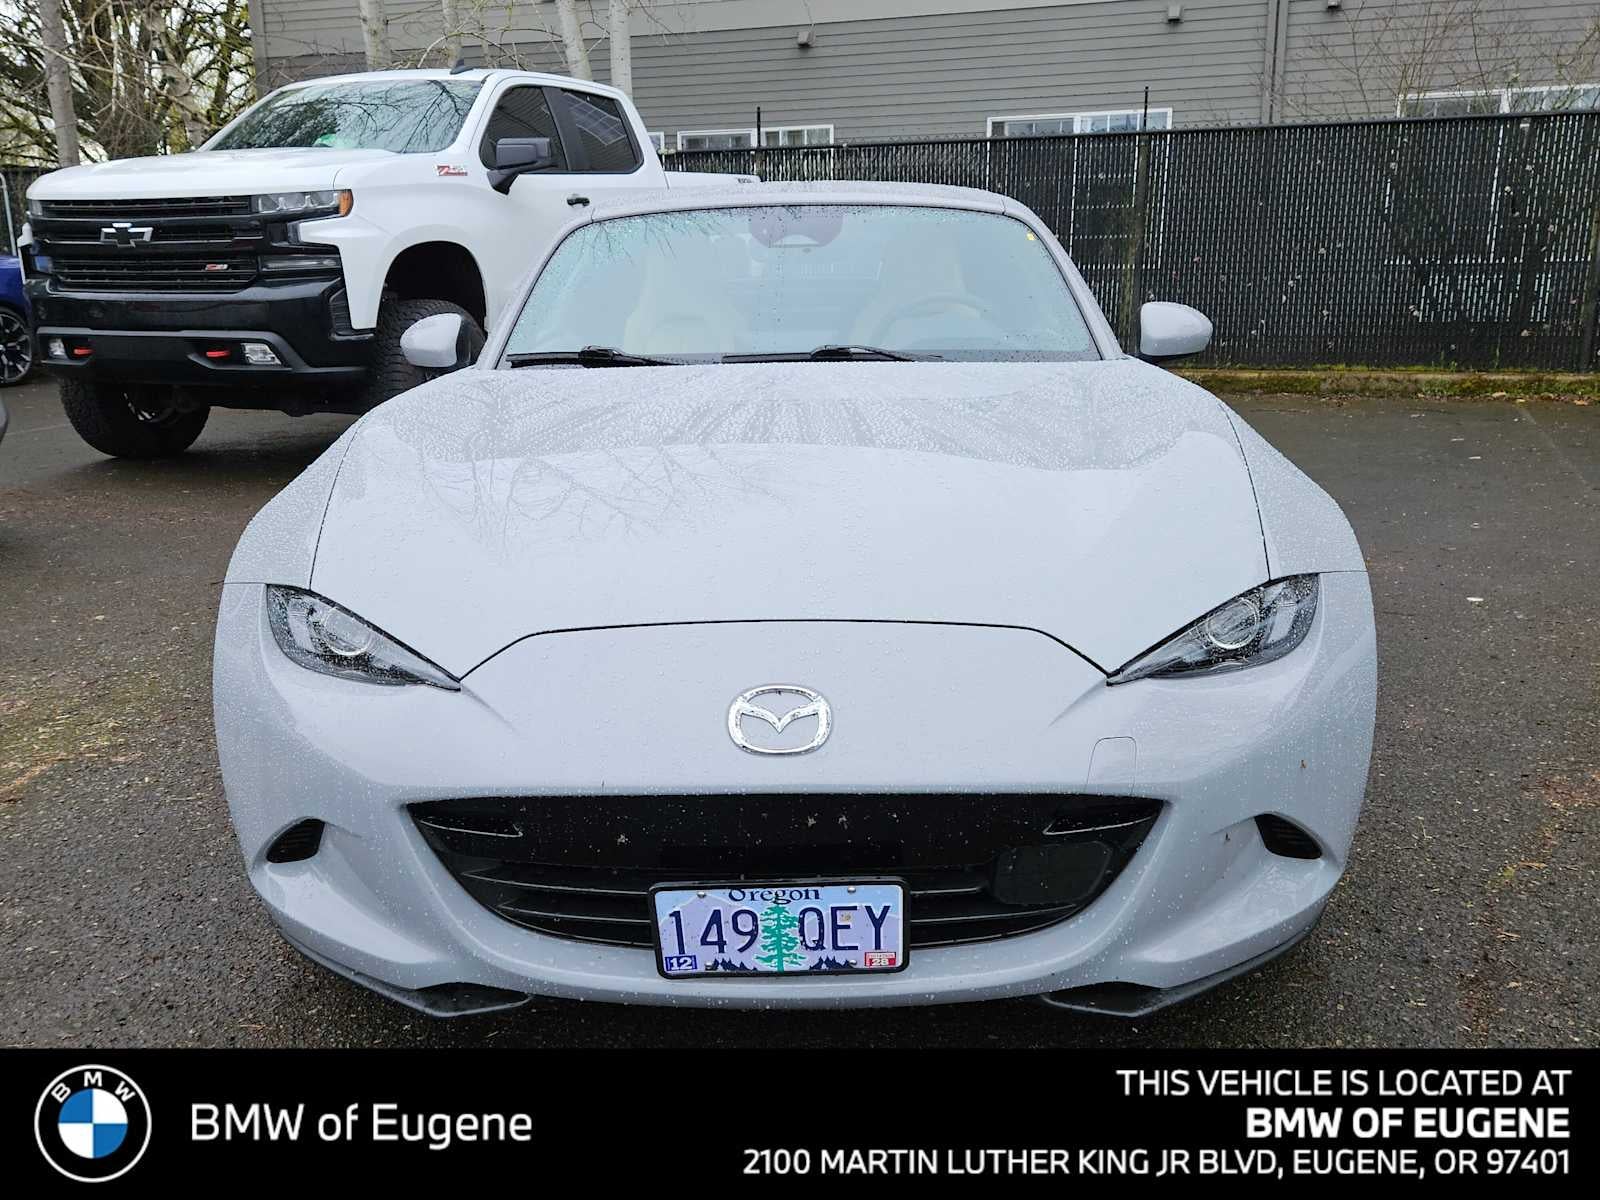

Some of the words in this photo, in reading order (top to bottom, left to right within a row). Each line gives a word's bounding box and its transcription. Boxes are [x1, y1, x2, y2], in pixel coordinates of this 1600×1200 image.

[728, 888, 822, 904] Oregon
[669, 908, 759, 954] 149
[798, 905, 891, 950] QEY
[669, 957, 693, 970] 12
[871, 958, 889, 966] 28
